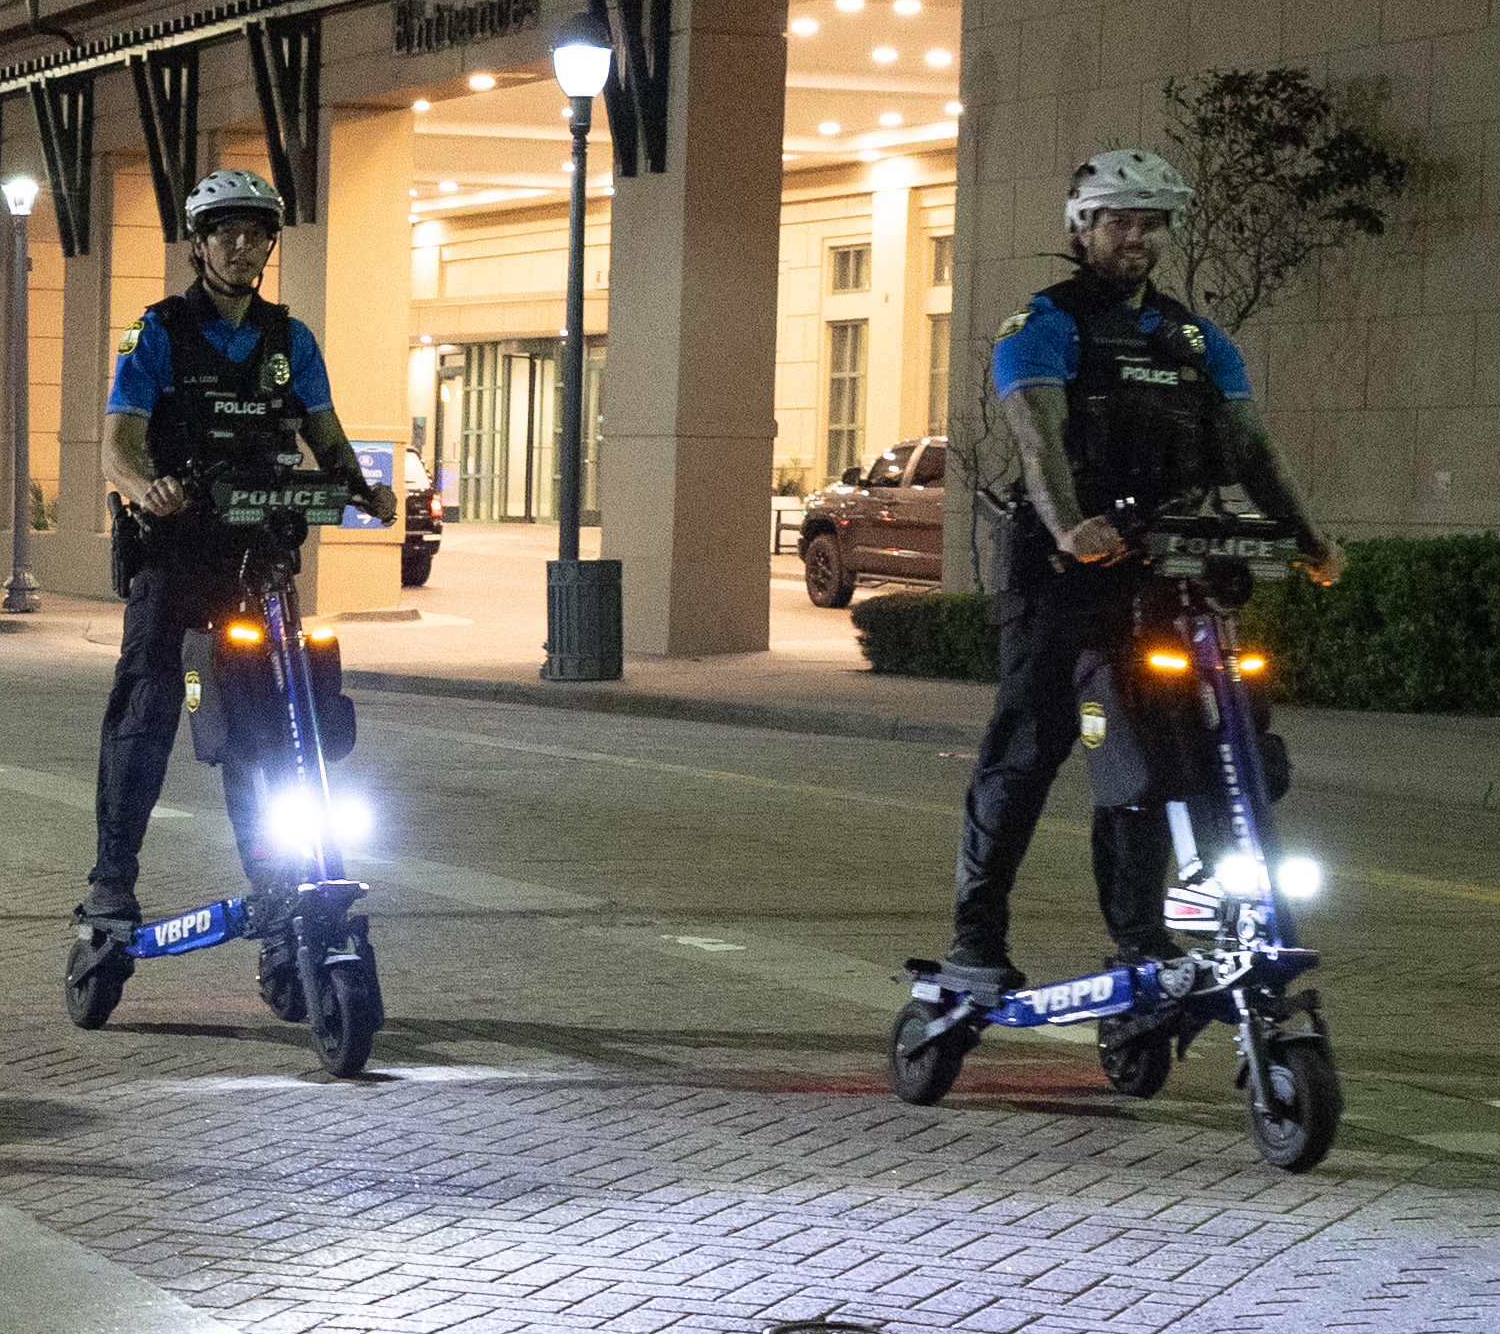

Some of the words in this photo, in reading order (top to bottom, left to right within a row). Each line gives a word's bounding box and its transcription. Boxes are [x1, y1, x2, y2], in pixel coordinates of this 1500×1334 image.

[1121, 366, 1179, 385] POLICE
[213, 400, 267, 415] POLICE
[229, 489, 328, 506] POLICE
[1166, 535, 1275, 558] POLICE
[154, 908, 212, 947] VBPD
[1031, 974, 1115, 1015] VBPD
